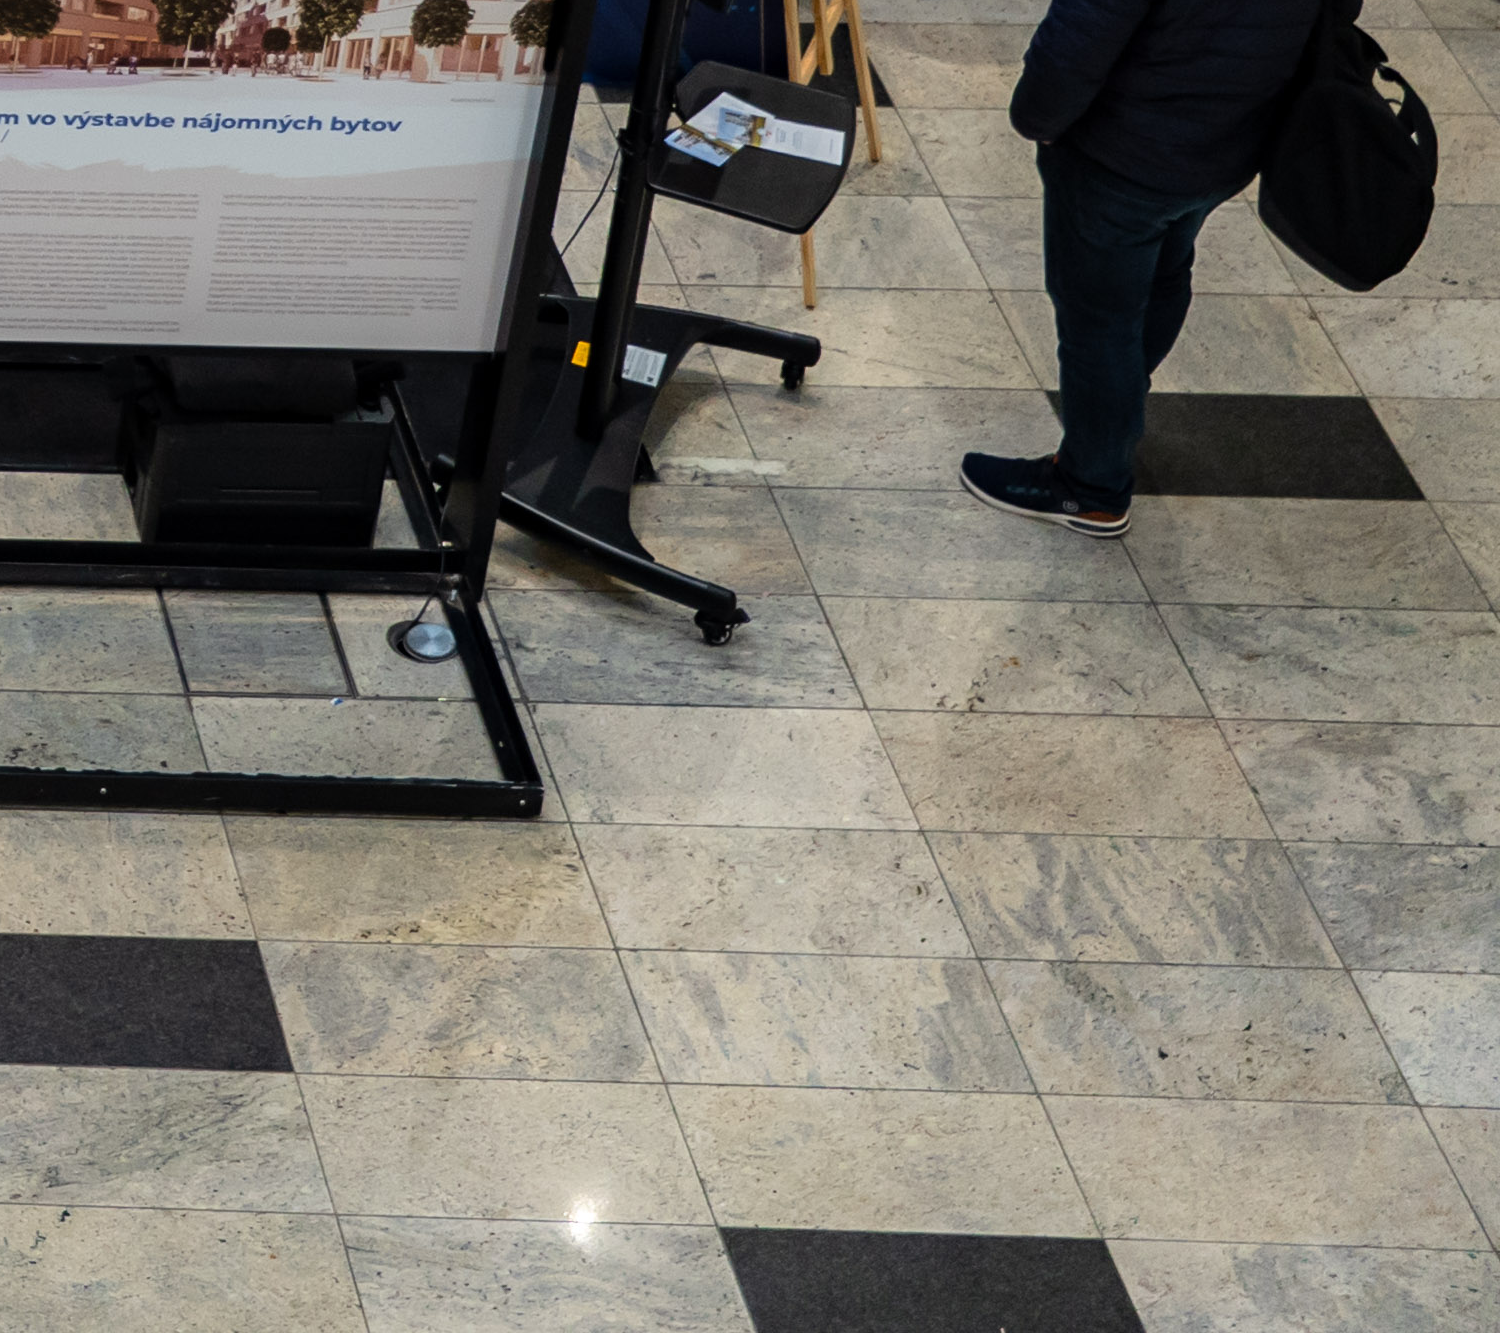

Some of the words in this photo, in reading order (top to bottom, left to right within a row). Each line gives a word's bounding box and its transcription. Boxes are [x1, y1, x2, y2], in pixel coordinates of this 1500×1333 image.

[27, 113, 56, 126] vo
[63, 110, 176, 130] výstavbe
[182, 112, 322, 134] nájomných
[329, 115, 403, 135] bytov
